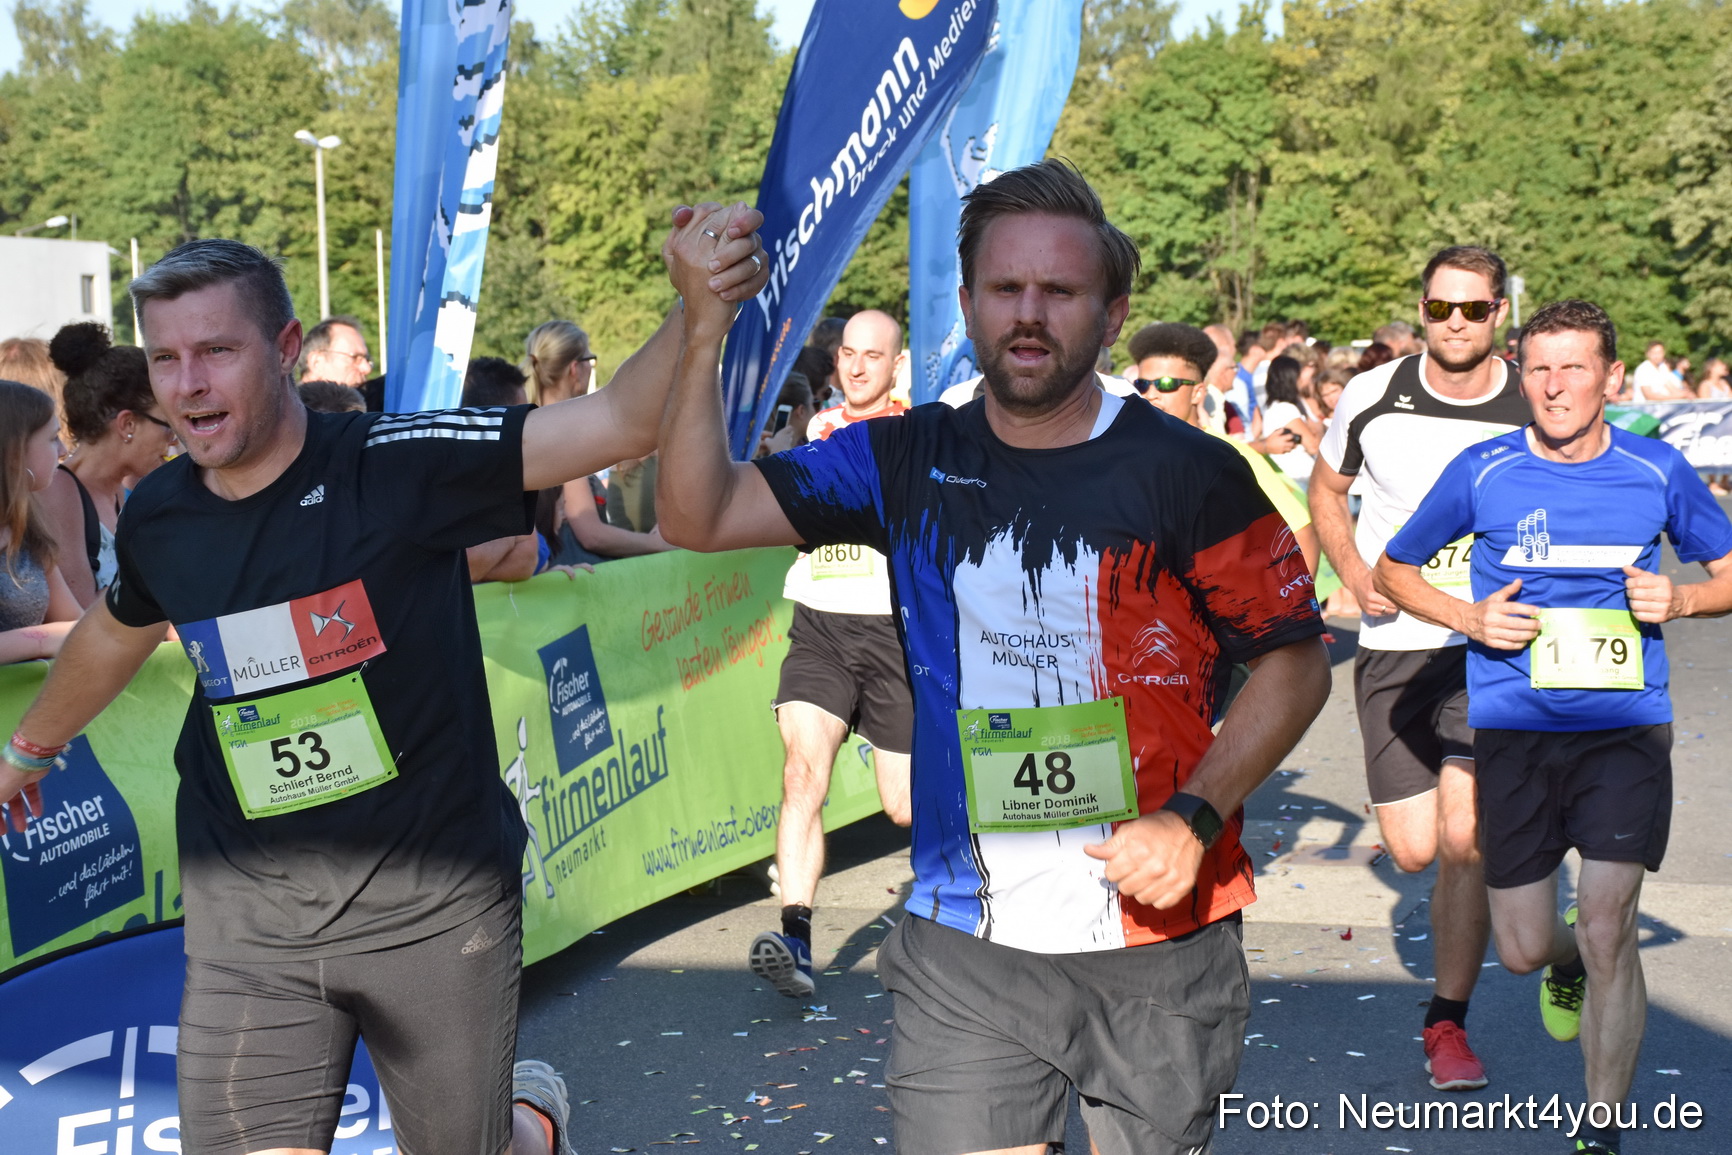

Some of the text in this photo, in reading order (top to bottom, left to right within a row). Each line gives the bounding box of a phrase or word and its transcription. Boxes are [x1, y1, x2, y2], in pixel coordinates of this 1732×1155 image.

[850, 127, 897, 198] Druck
[898, 71, 927, 130] und
[755, 36, 920, 332] Frischmann
[815, 544, 862, 563] 1860
[704, 571, 754, 617] Firmen
[722, 600, 783, 667] länger!
[980, 630, 1071, 649] AUTOHAUS
[1546, 637, 1628, 665] 179
[992, 650, 1058, 669] MÜLLER
[556, 671, 590, 706] Fischer
[561, 692, 592, 717] AUTOMOBILE
[233, 713, 281, 732] firmenlauf
[290, 714, 318, 729] 2018
[980, 728, 1071, 747] firmenlauf 2018
[270, 731, 331, 778] 53
[269, 776, 314, 795] Schlierf
[317, 765, 354, 784] Bernd
[270, 791, 307, 804] Autohaus
[308, 784, 333, 796] Müller
[333, 775, 360, 788] GmbH
[541, 704, 669, 851] firmenlauf
[1013, 751, 1076, 796] 48
[1002, 793, 1098, 811] Libner Dominik
[1002, 805, 1100, 821] Autohaus Müller GmbH
[24, 794, 105, 850] Fischer
[642, 800, 784, 877] www.firmenlauf-ober
[39, 823, 111, 866] AUTOMOBILE
[555, 824, 607, 885] neumarkt
